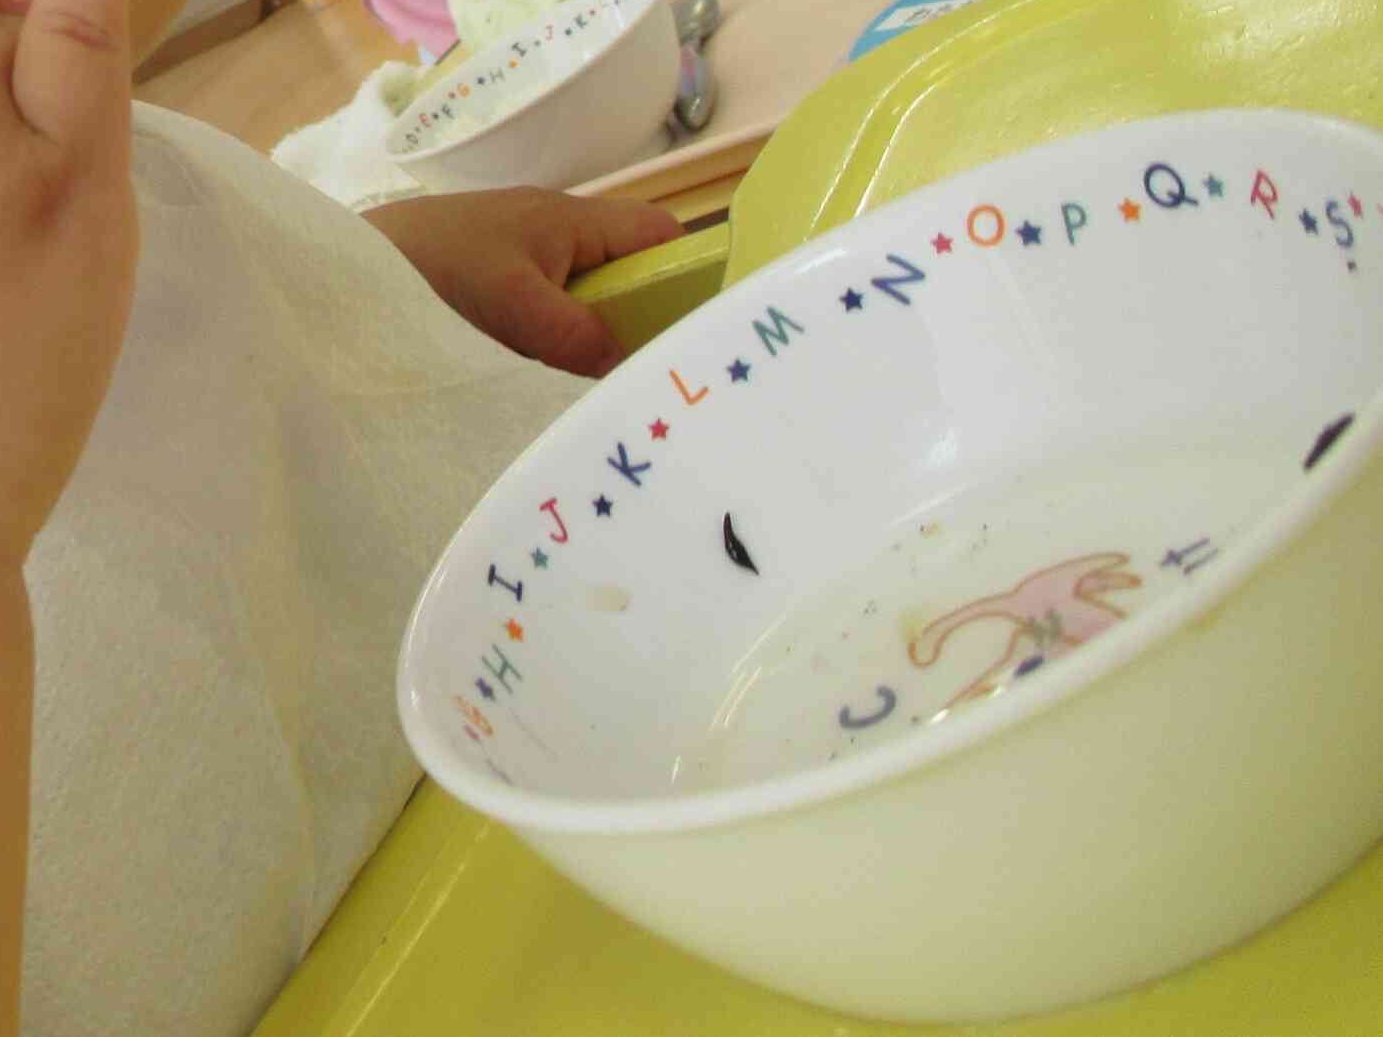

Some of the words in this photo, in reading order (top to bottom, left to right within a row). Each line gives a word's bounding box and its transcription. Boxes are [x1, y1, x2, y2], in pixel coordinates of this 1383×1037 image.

[512, 41, 529, 59] I
[1144, 162, 1200, 209] Q
[1250, 168, 1279, 221] R
[966, 203, 1006, 248] O
[1061, 202, 1088, 247] P
[1325, 199, 1355, 248] S
[870, 253, 926, 306] N
[751, 306, 806, 357] M
[669, 368, 710, 406] L
[605, 441, 653, 488] K
[539, 496, 569, 545] J
[487, 563, 523, 603] I
[481, 642, 523, 695] H
